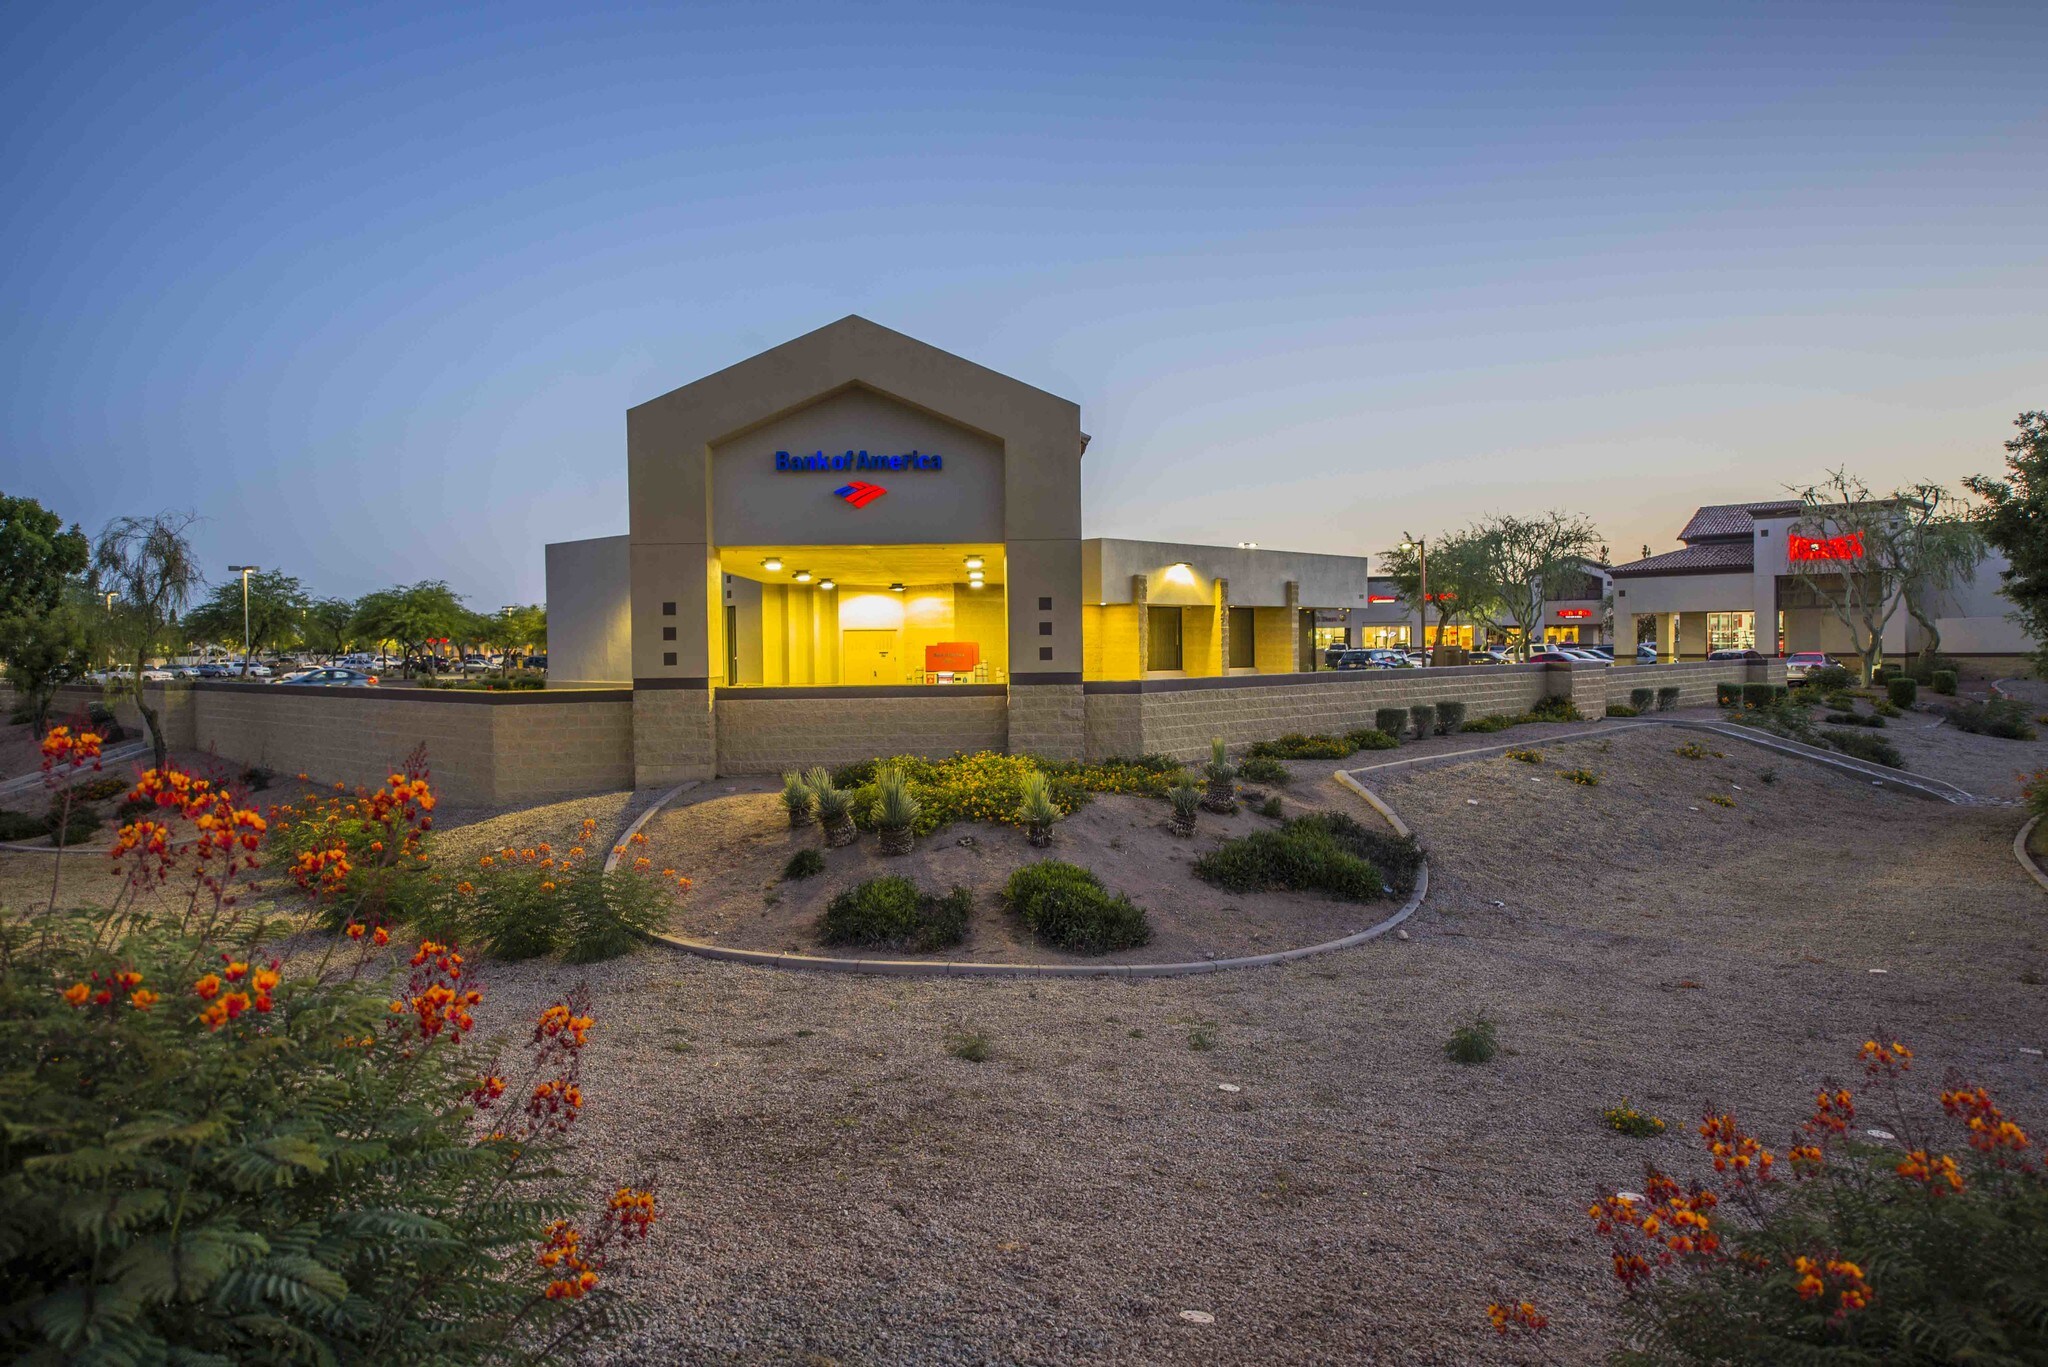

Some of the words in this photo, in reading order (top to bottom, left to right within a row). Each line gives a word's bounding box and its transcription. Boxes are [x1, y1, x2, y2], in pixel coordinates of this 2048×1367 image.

[776, 450, 829, 471] Bank
[831, 450, 853, 471] of
[856, 450, 942, 471] America
